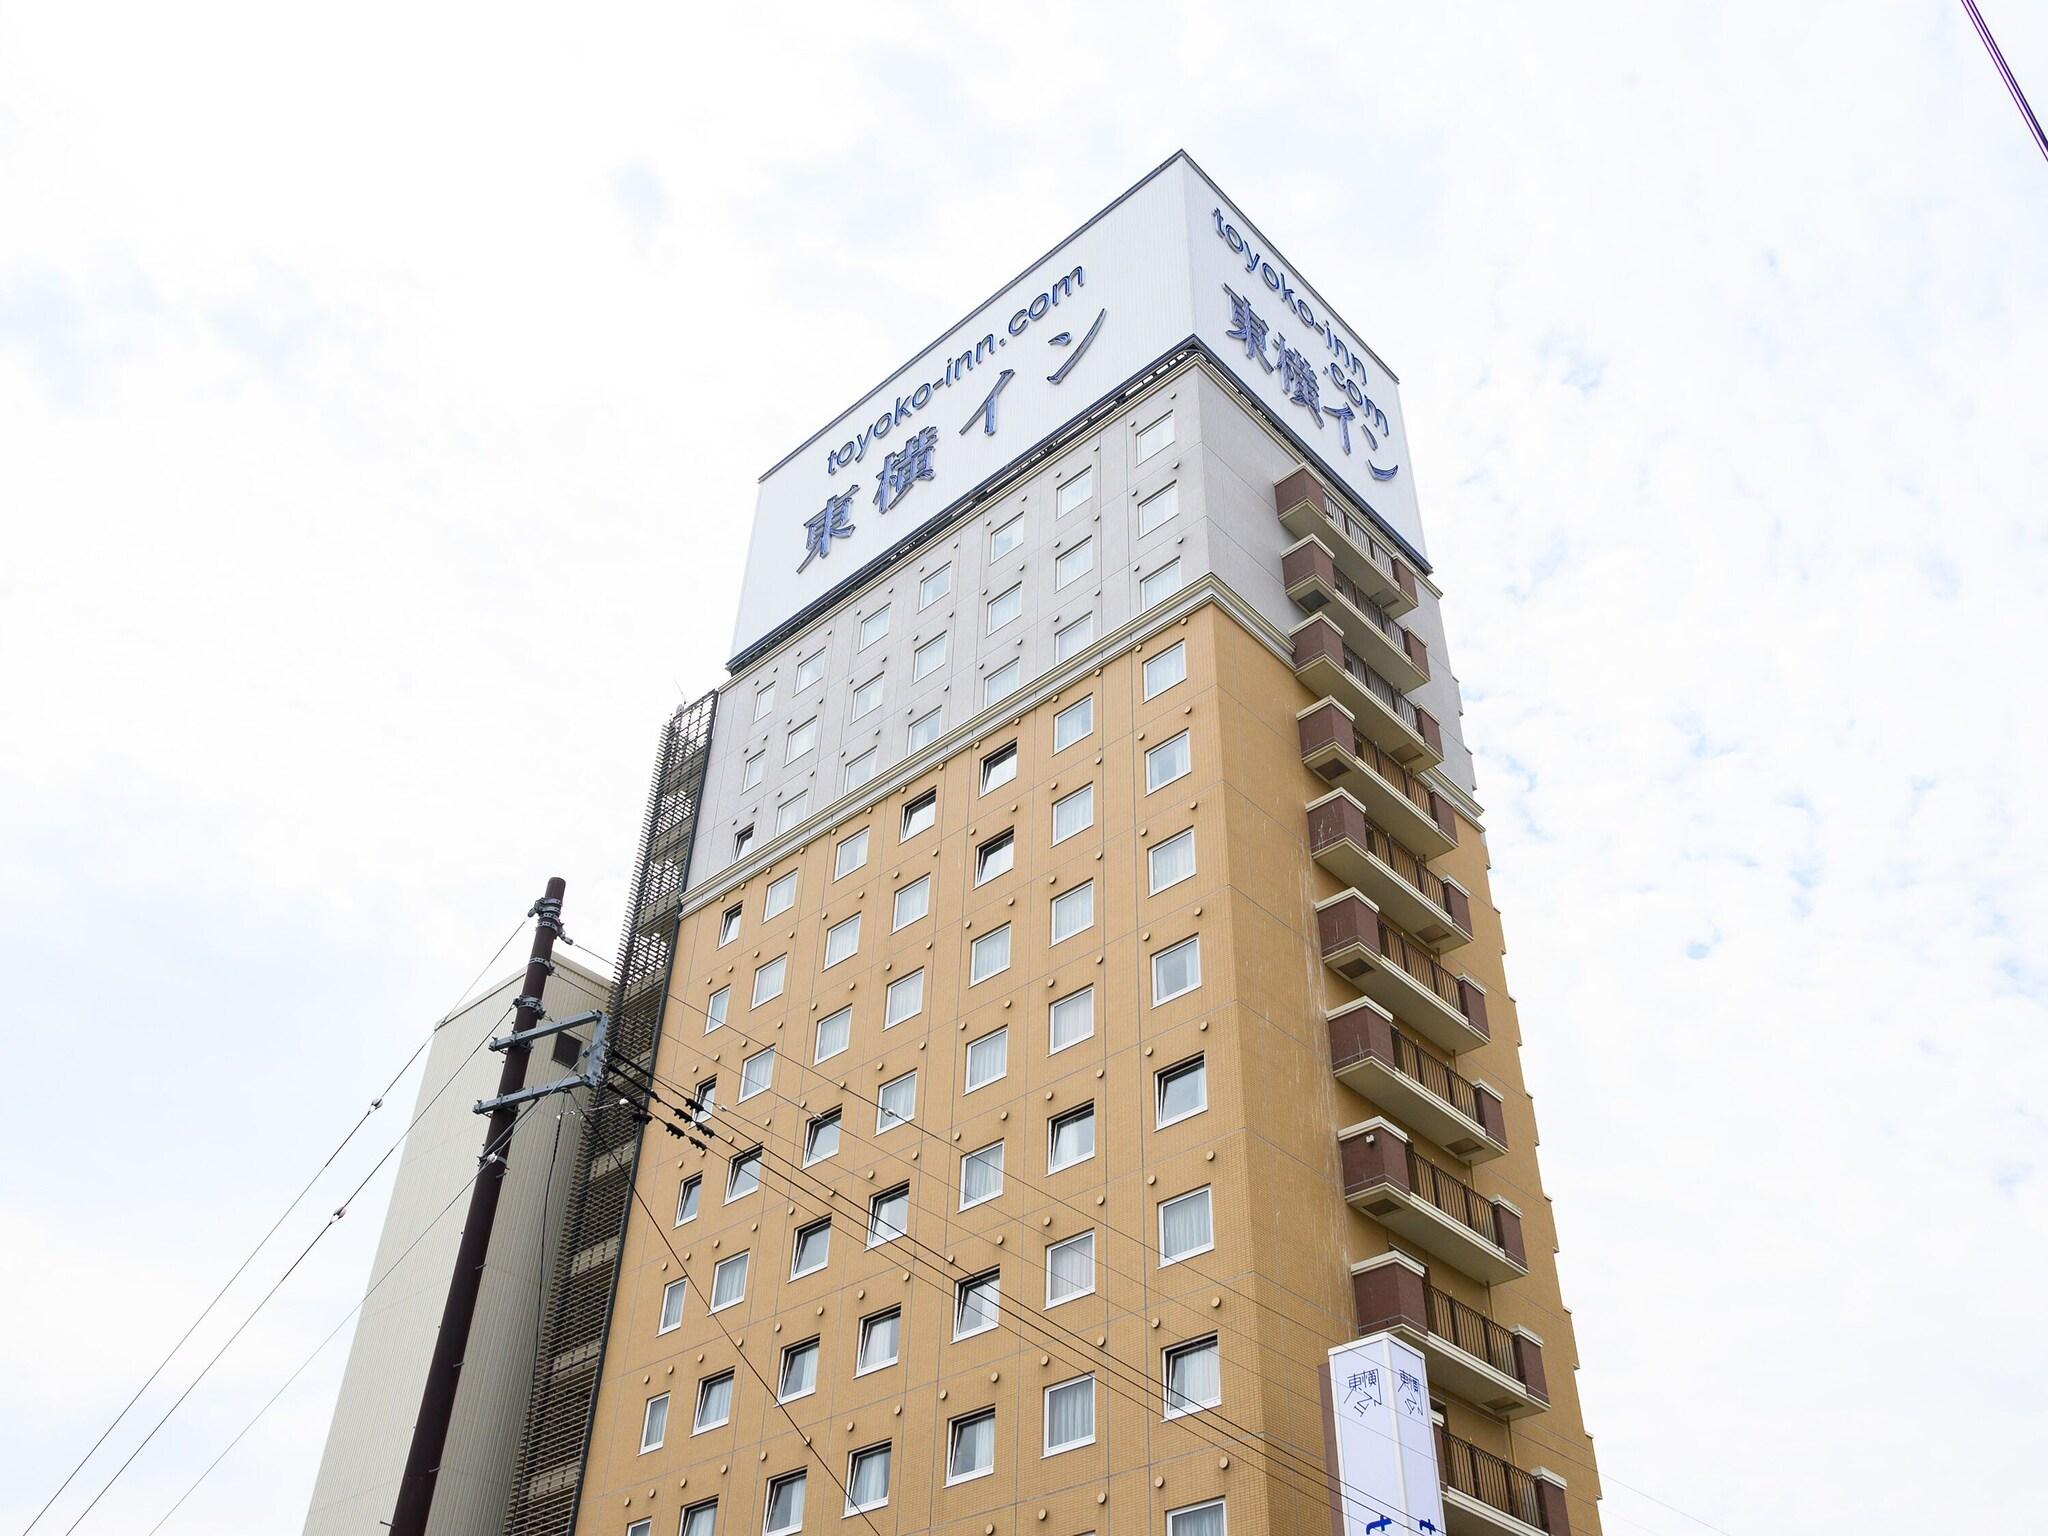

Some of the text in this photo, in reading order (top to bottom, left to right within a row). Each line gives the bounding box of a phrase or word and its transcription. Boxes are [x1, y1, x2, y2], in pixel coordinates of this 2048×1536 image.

[827, 265, 1085, 475] toyoko-inn.com
[1212, 207, 1389, 437] toyoko-inn.com
[1221, 282, 1399, 481] 東横イン
[797, 308, 1107, 574] 東横イン
